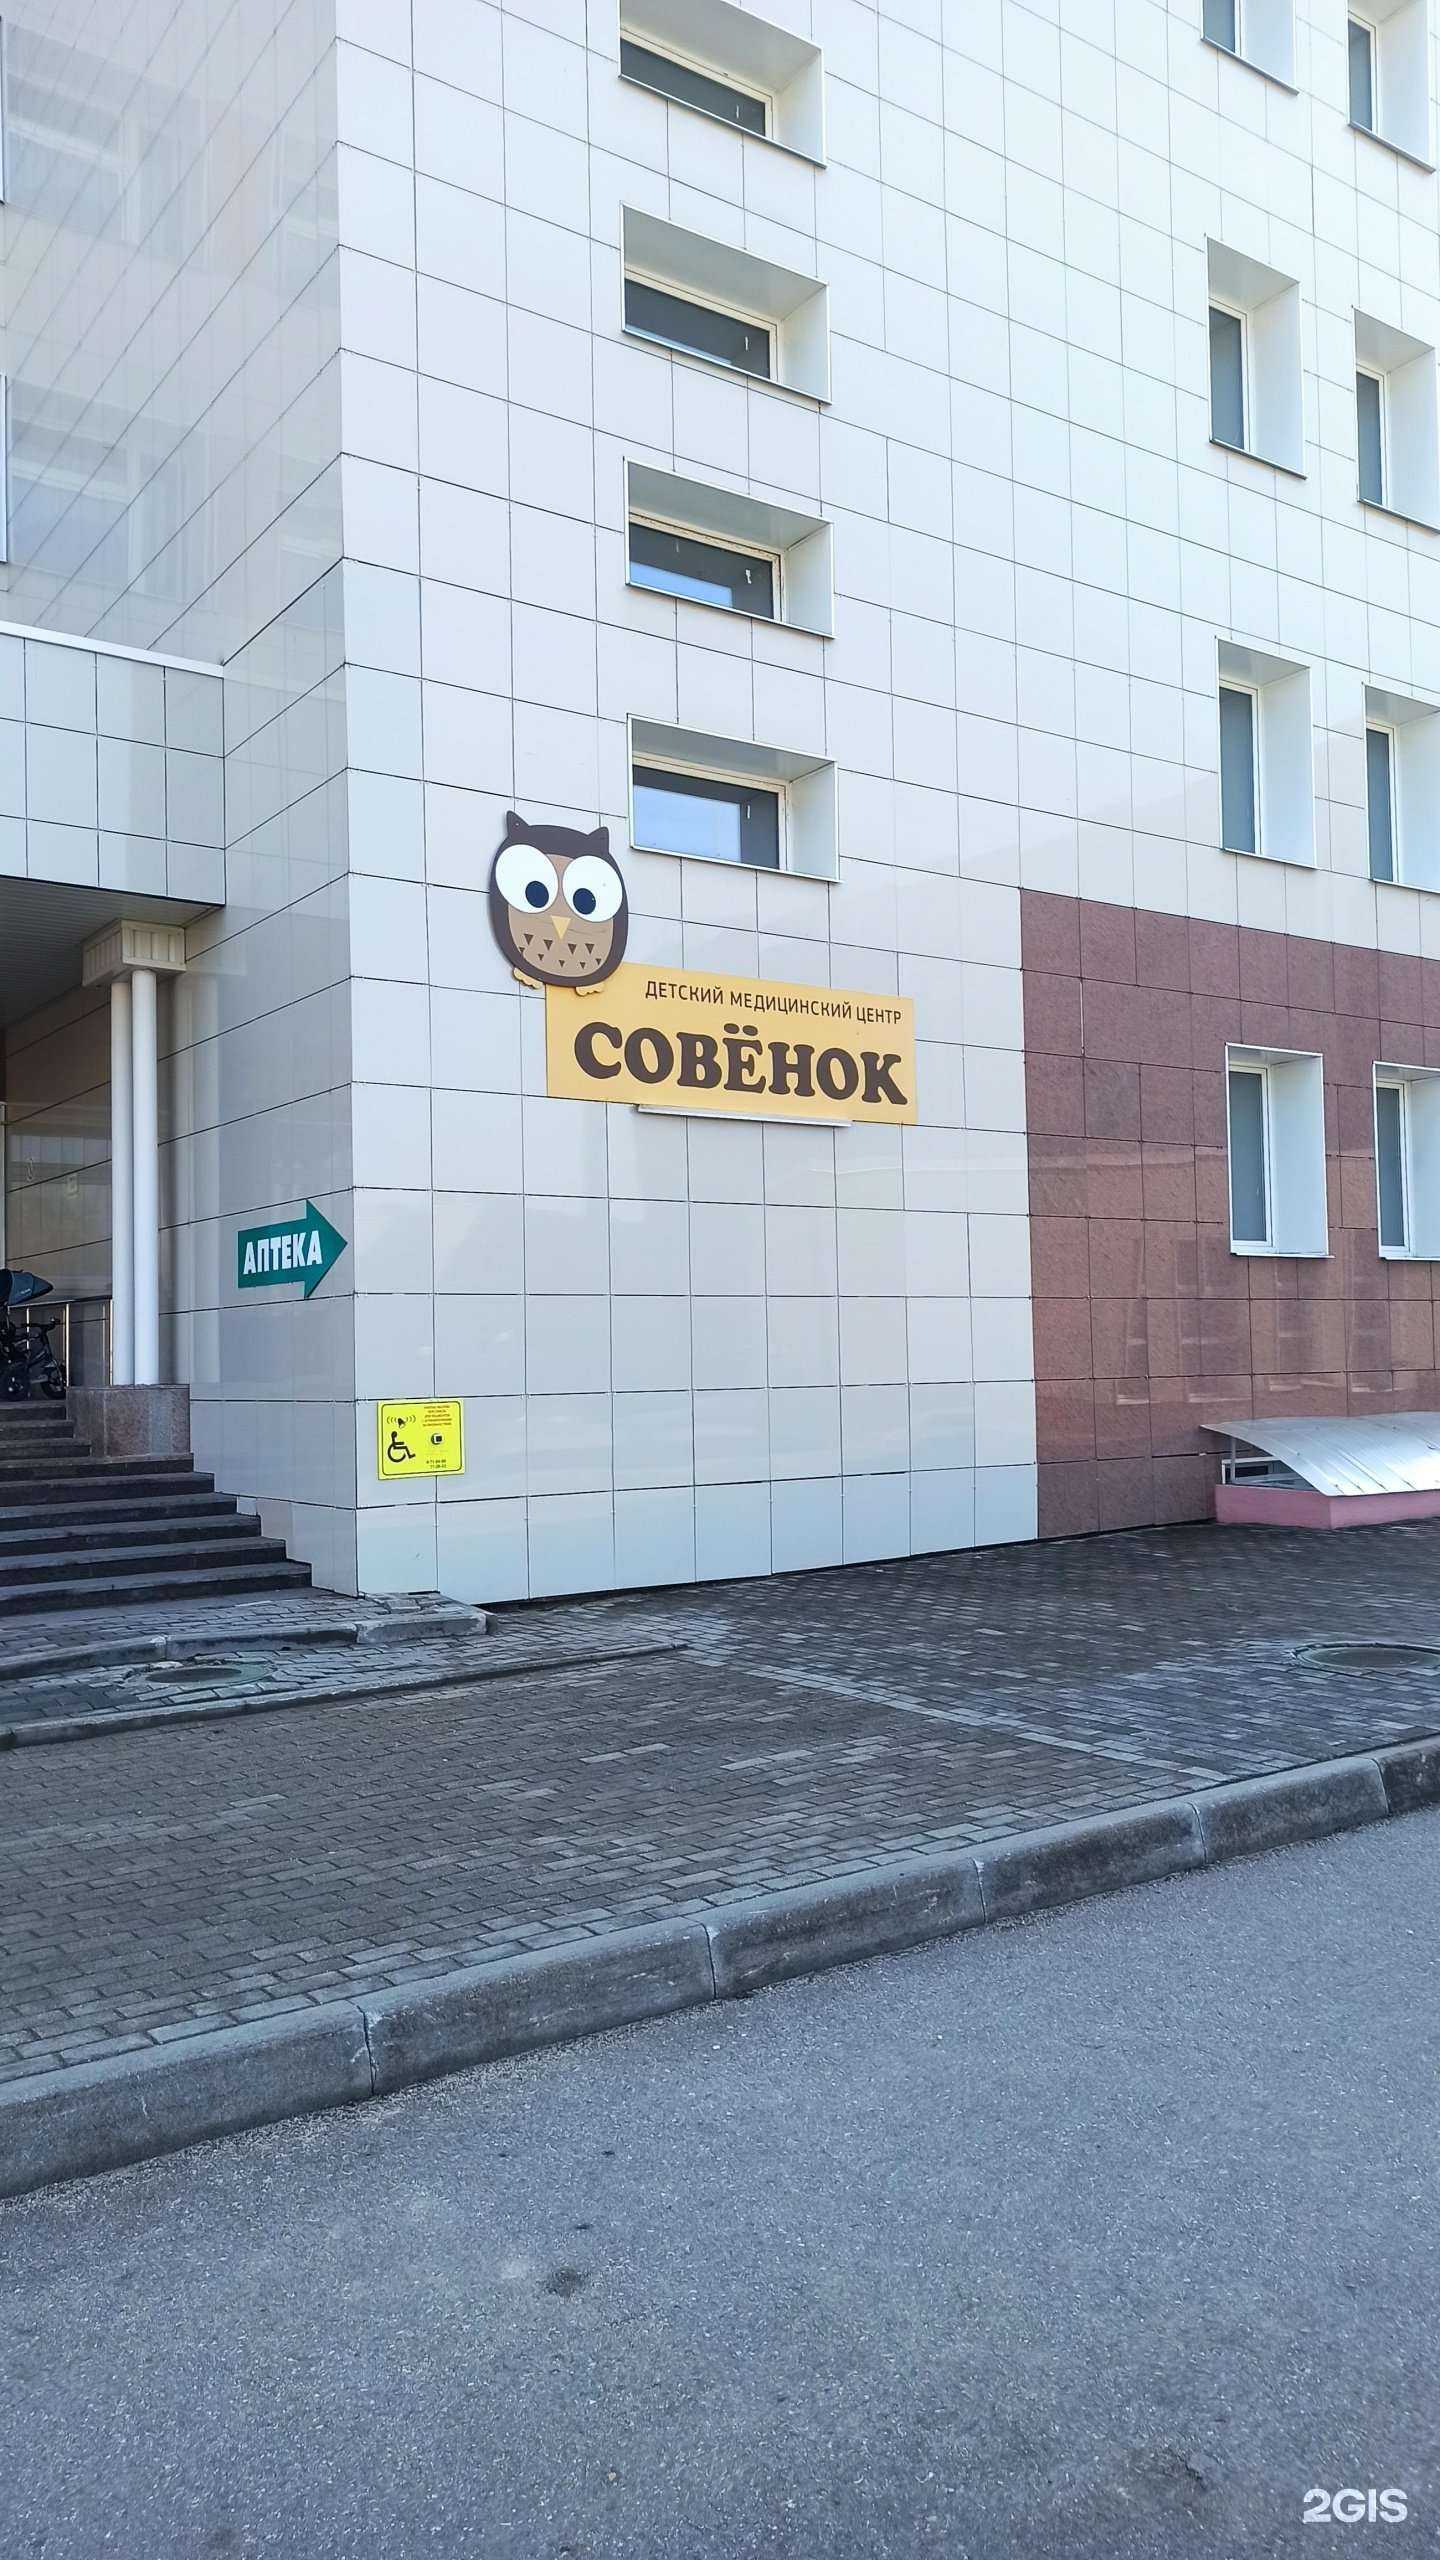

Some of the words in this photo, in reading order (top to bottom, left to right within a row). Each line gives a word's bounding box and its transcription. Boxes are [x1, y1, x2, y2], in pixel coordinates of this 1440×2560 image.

[645, 980, 724, 1004] ДЕТСКИЙ
[730, 991, 852, 1019] МЕДИЦИНСКИЙ
[856, 1006, 902, 1025] ЦЕНТР
[574, 1021, 908, 1106] СОВЁНОК
[242, 1229, 324, 1276] АПТЕКА
